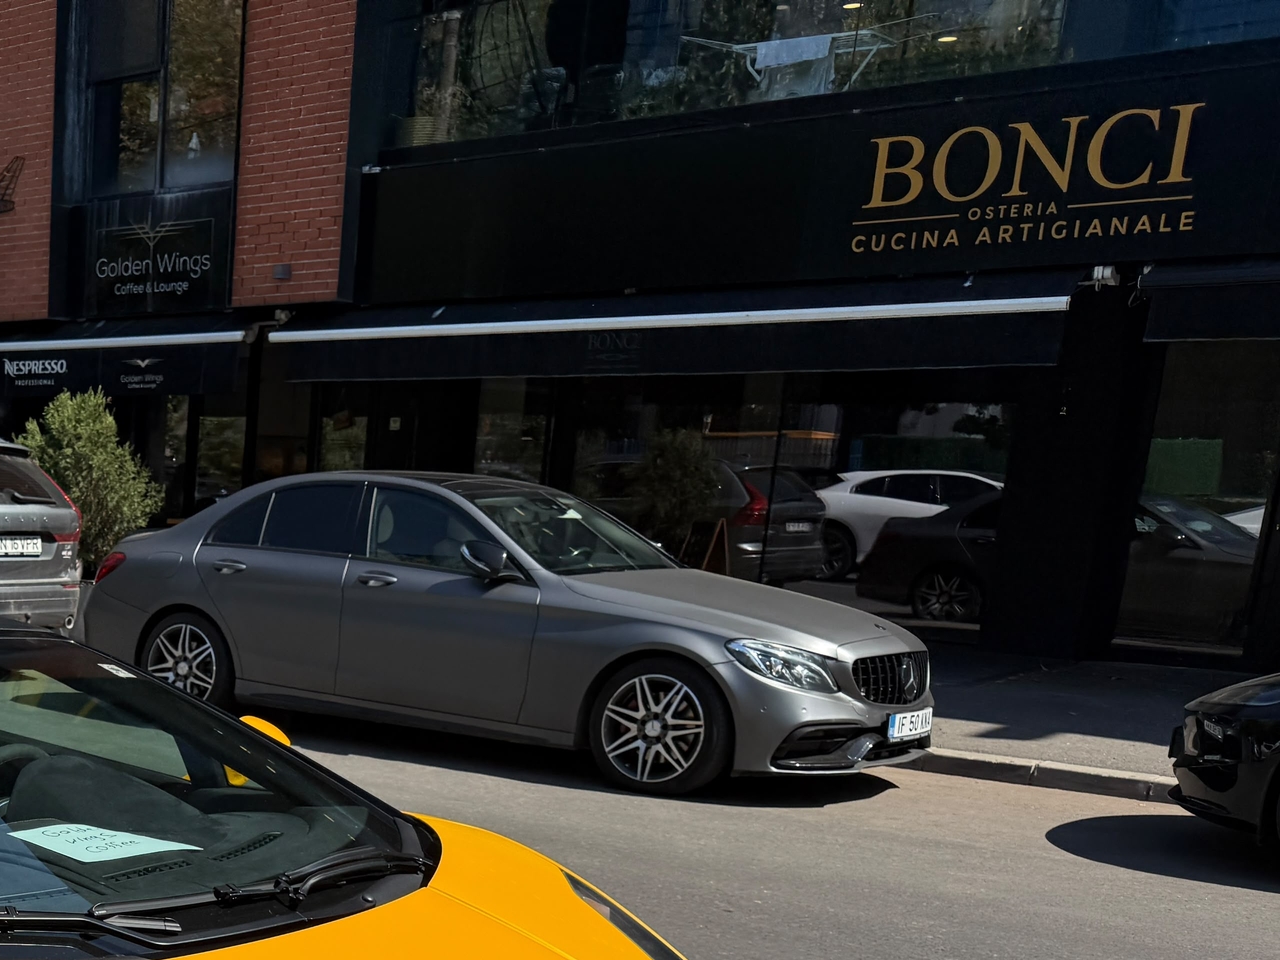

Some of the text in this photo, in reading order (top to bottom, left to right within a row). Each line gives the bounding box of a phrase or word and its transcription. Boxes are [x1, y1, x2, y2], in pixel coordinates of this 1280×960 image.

[861, 102, 1206, 209] BONCI
[967, 201, 1058, 221] OSTERIA
[851, 211, 1195, 253] CUCINA ARTIGIANALE
[95, 252, 211, 278] Golden Wings
[114, 281, 189, 295] Coffee & Lounge
[2, 358, 67, 377] NESPRESSO
[21, 536, 39, 550] VPR
[897, 716, 907, 734] IF
[909, 714, 920, 732] 50
